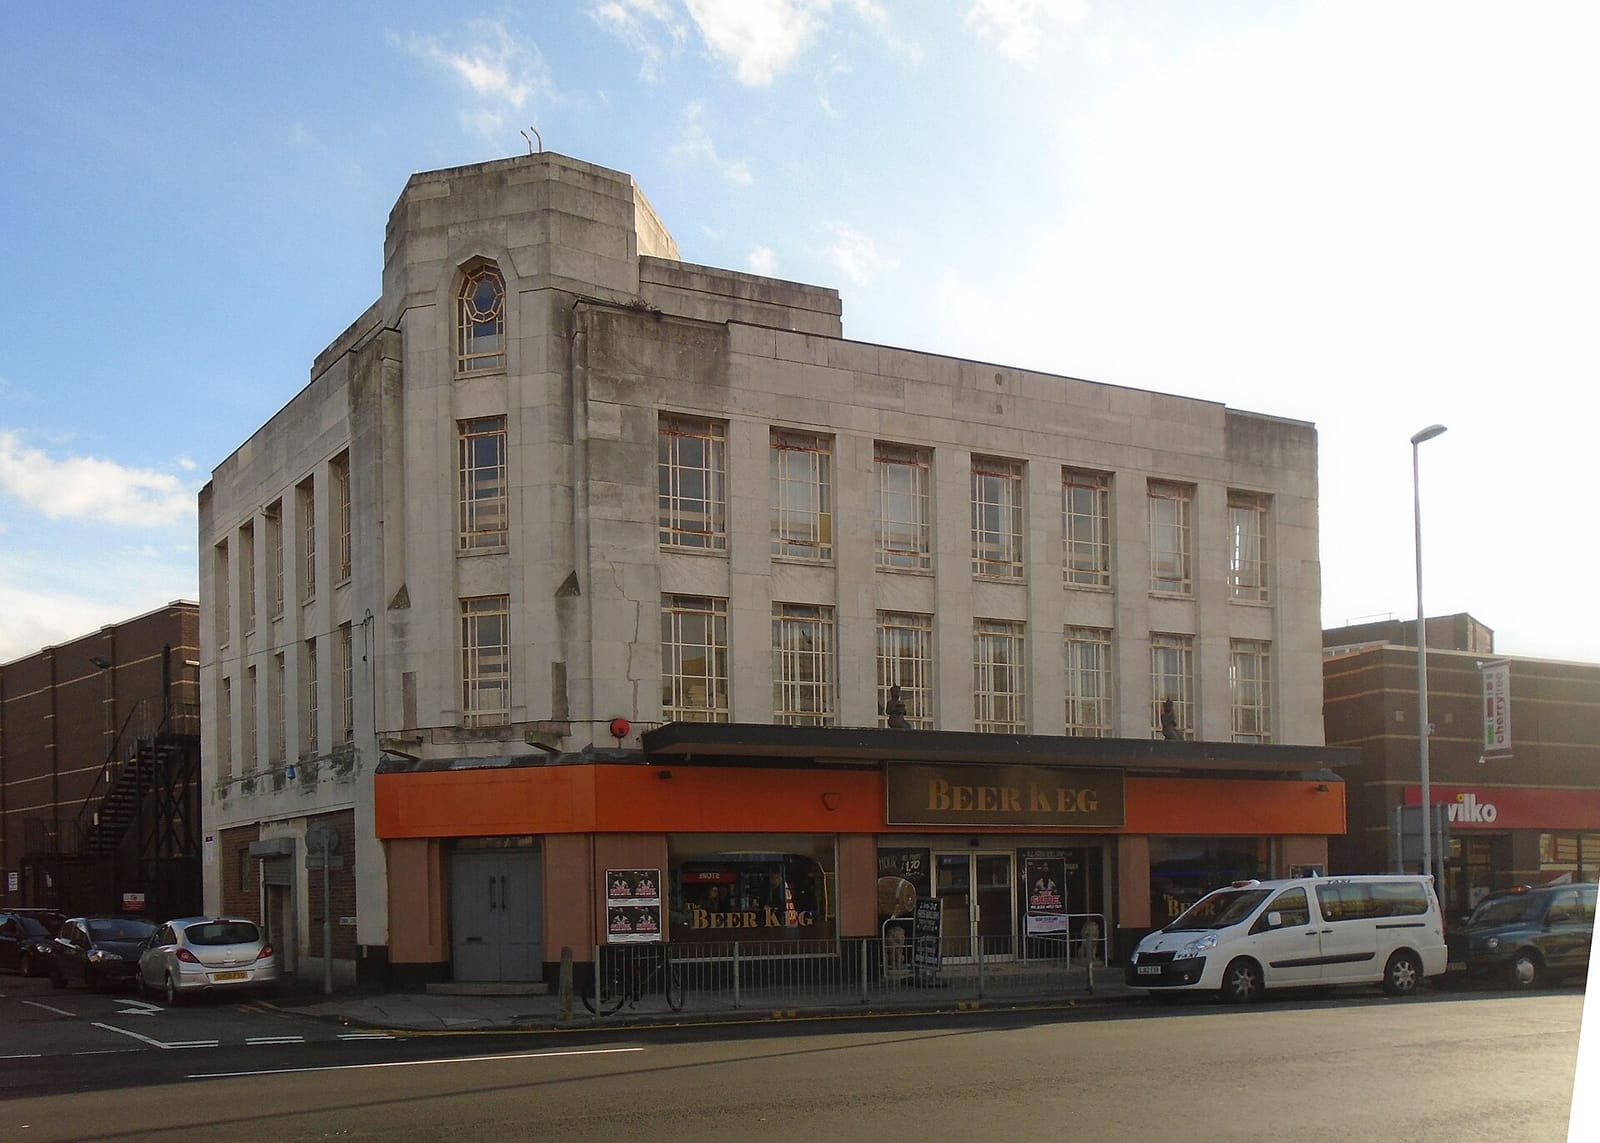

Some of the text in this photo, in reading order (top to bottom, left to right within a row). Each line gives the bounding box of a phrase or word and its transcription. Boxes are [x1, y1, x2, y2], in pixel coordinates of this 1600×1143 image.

[927, 778, 1099, 813] BEER KEG
[691, 904, 816, 930] BEER KEG
